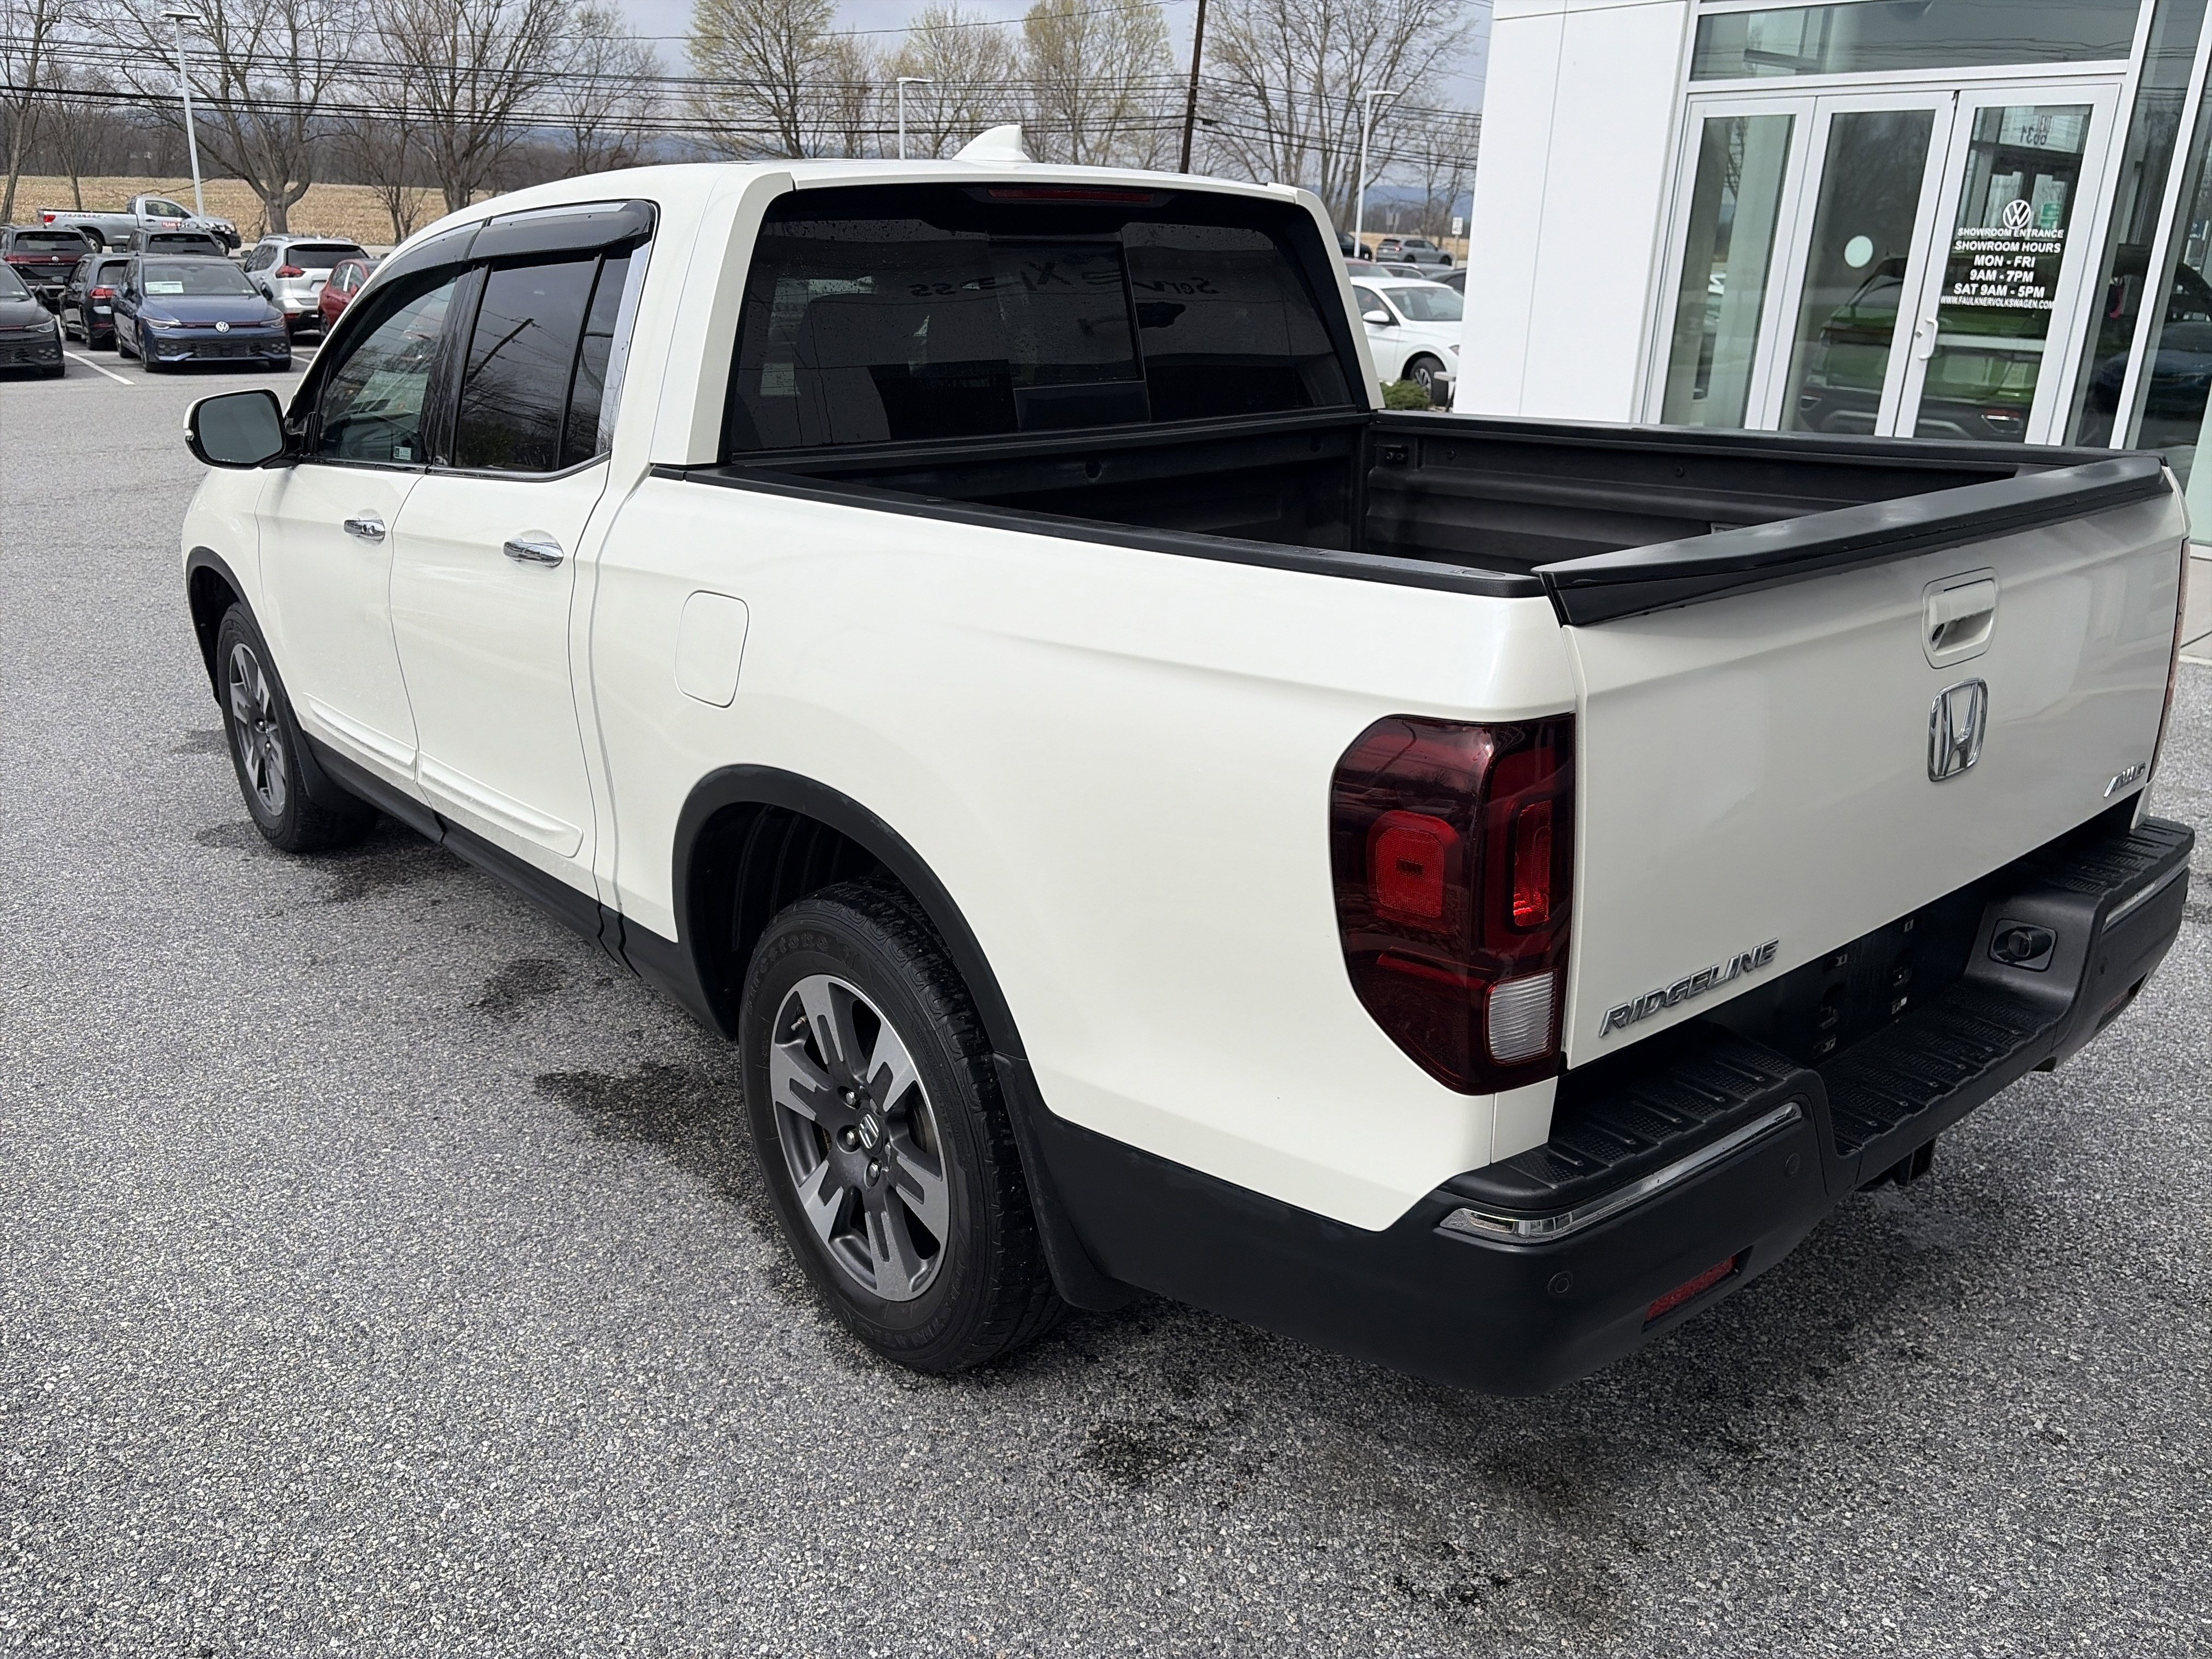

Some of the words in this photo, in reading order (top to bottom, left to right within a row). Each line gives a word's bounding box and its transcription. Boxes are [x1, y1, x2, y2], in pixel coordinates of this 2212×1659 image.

[1957, 228, 2012, 238] SHOWROOM
[2013, 228, 2064, 238] ENTRANCE
[1955, 240, 2020, 252] SHOWROOM
[2022, 242, 2062, 253] HOURS
[1974, 255, 2004, 267] MON
[2013, 256, 2036, 268] FRI
[1970, 269, 1997, 281] 9AM
[2006, 270, 2034, 283] 7PM
[1953, 283, 1979, 295] SAT
[1980, 284, 2008, 297] 9AM
[2017, 286, 2045, 298] 5PM
[1940, 295, 2055, 309] WWW.FAULKNERVOLKSWAGEN.COM
[1598, 936, 1779, 1039] RIDGELINE
